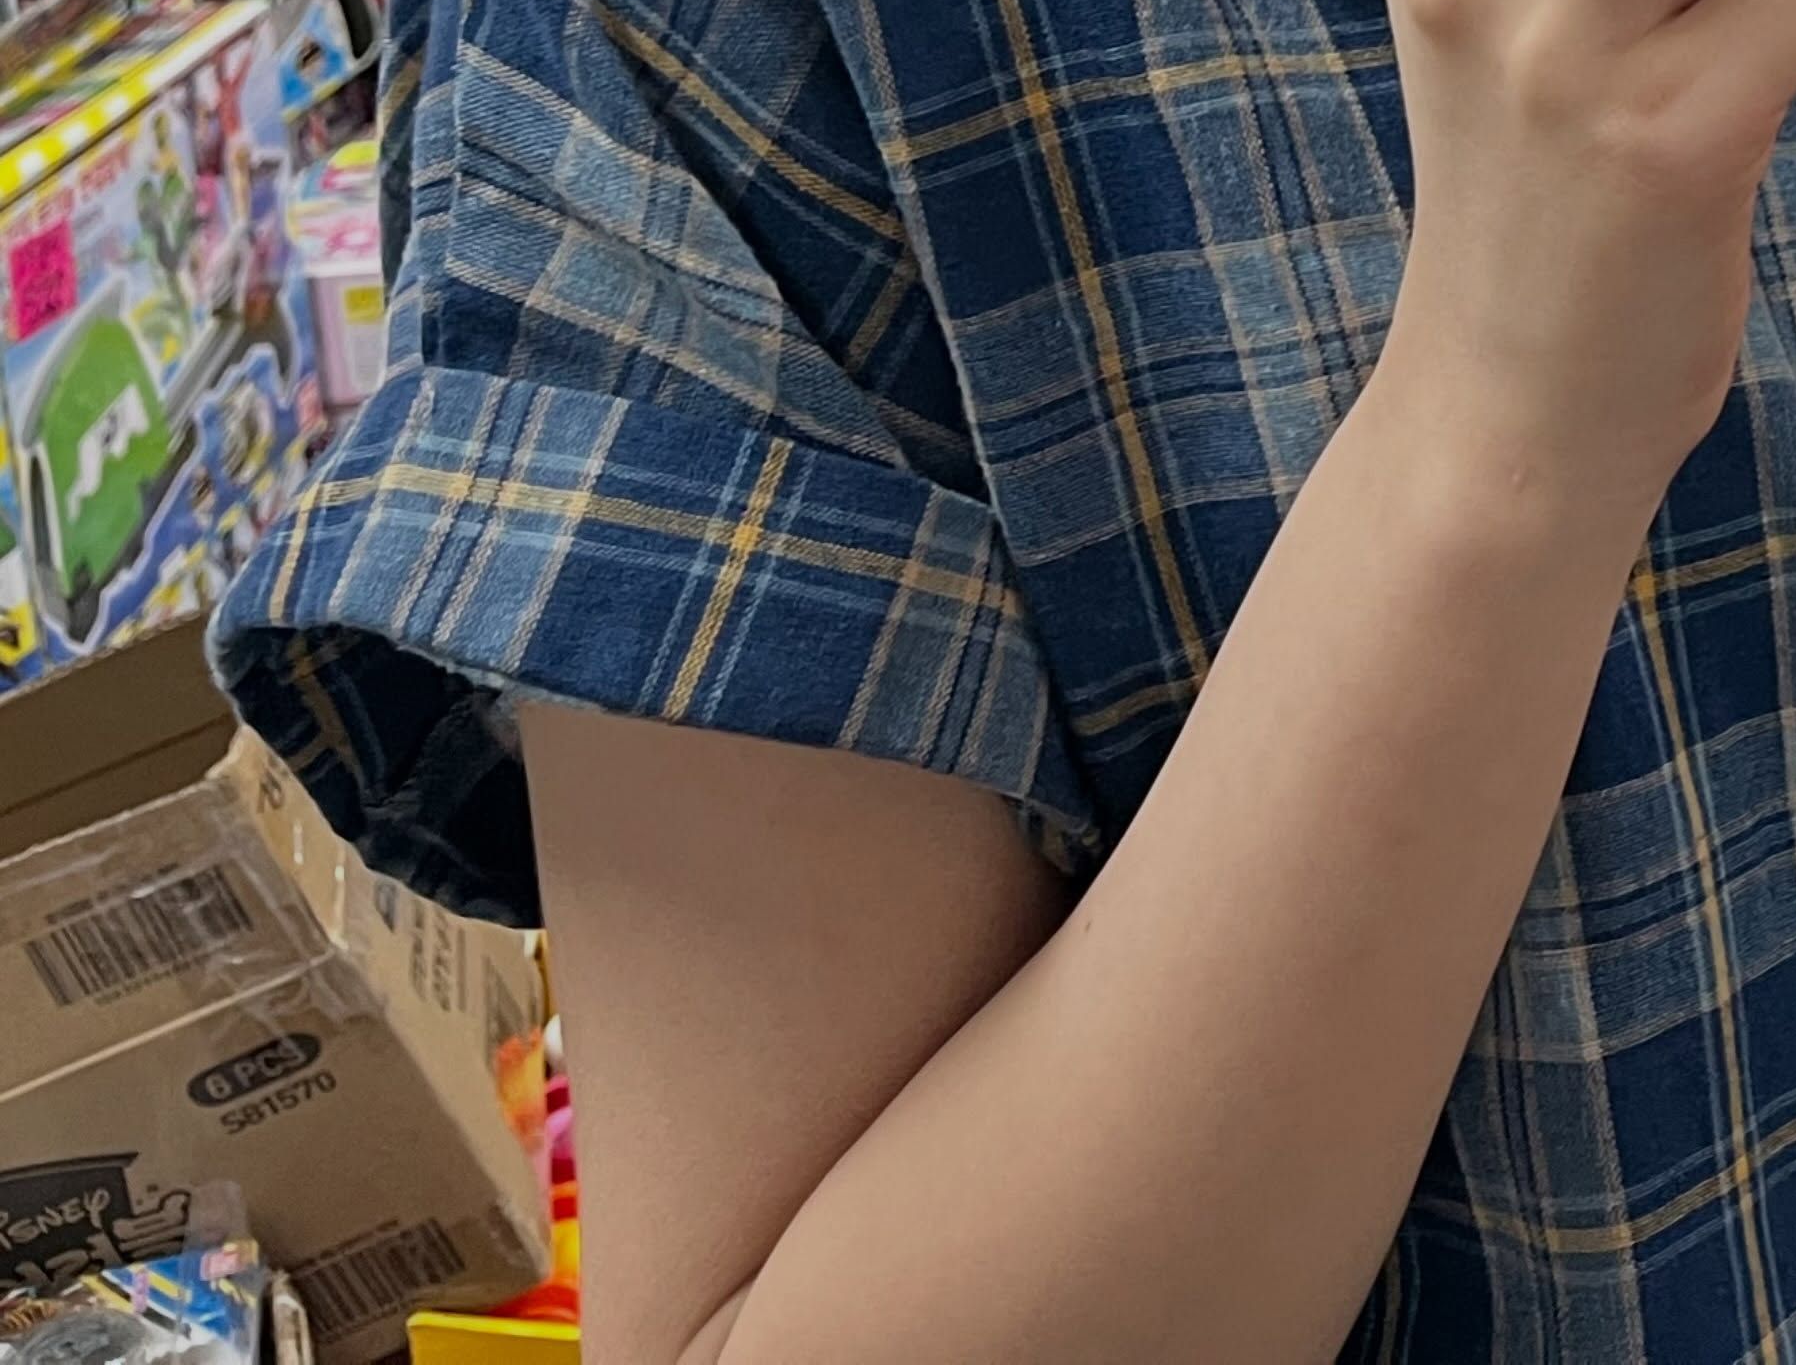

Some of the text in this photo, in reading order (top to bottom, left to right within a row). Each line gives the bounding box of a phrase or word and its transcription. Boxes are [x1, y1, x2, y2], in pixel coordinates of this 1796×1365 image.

[206, 1044, 304, 1102] 6 PCS
[219, 1070, 339, 1137] S81570
